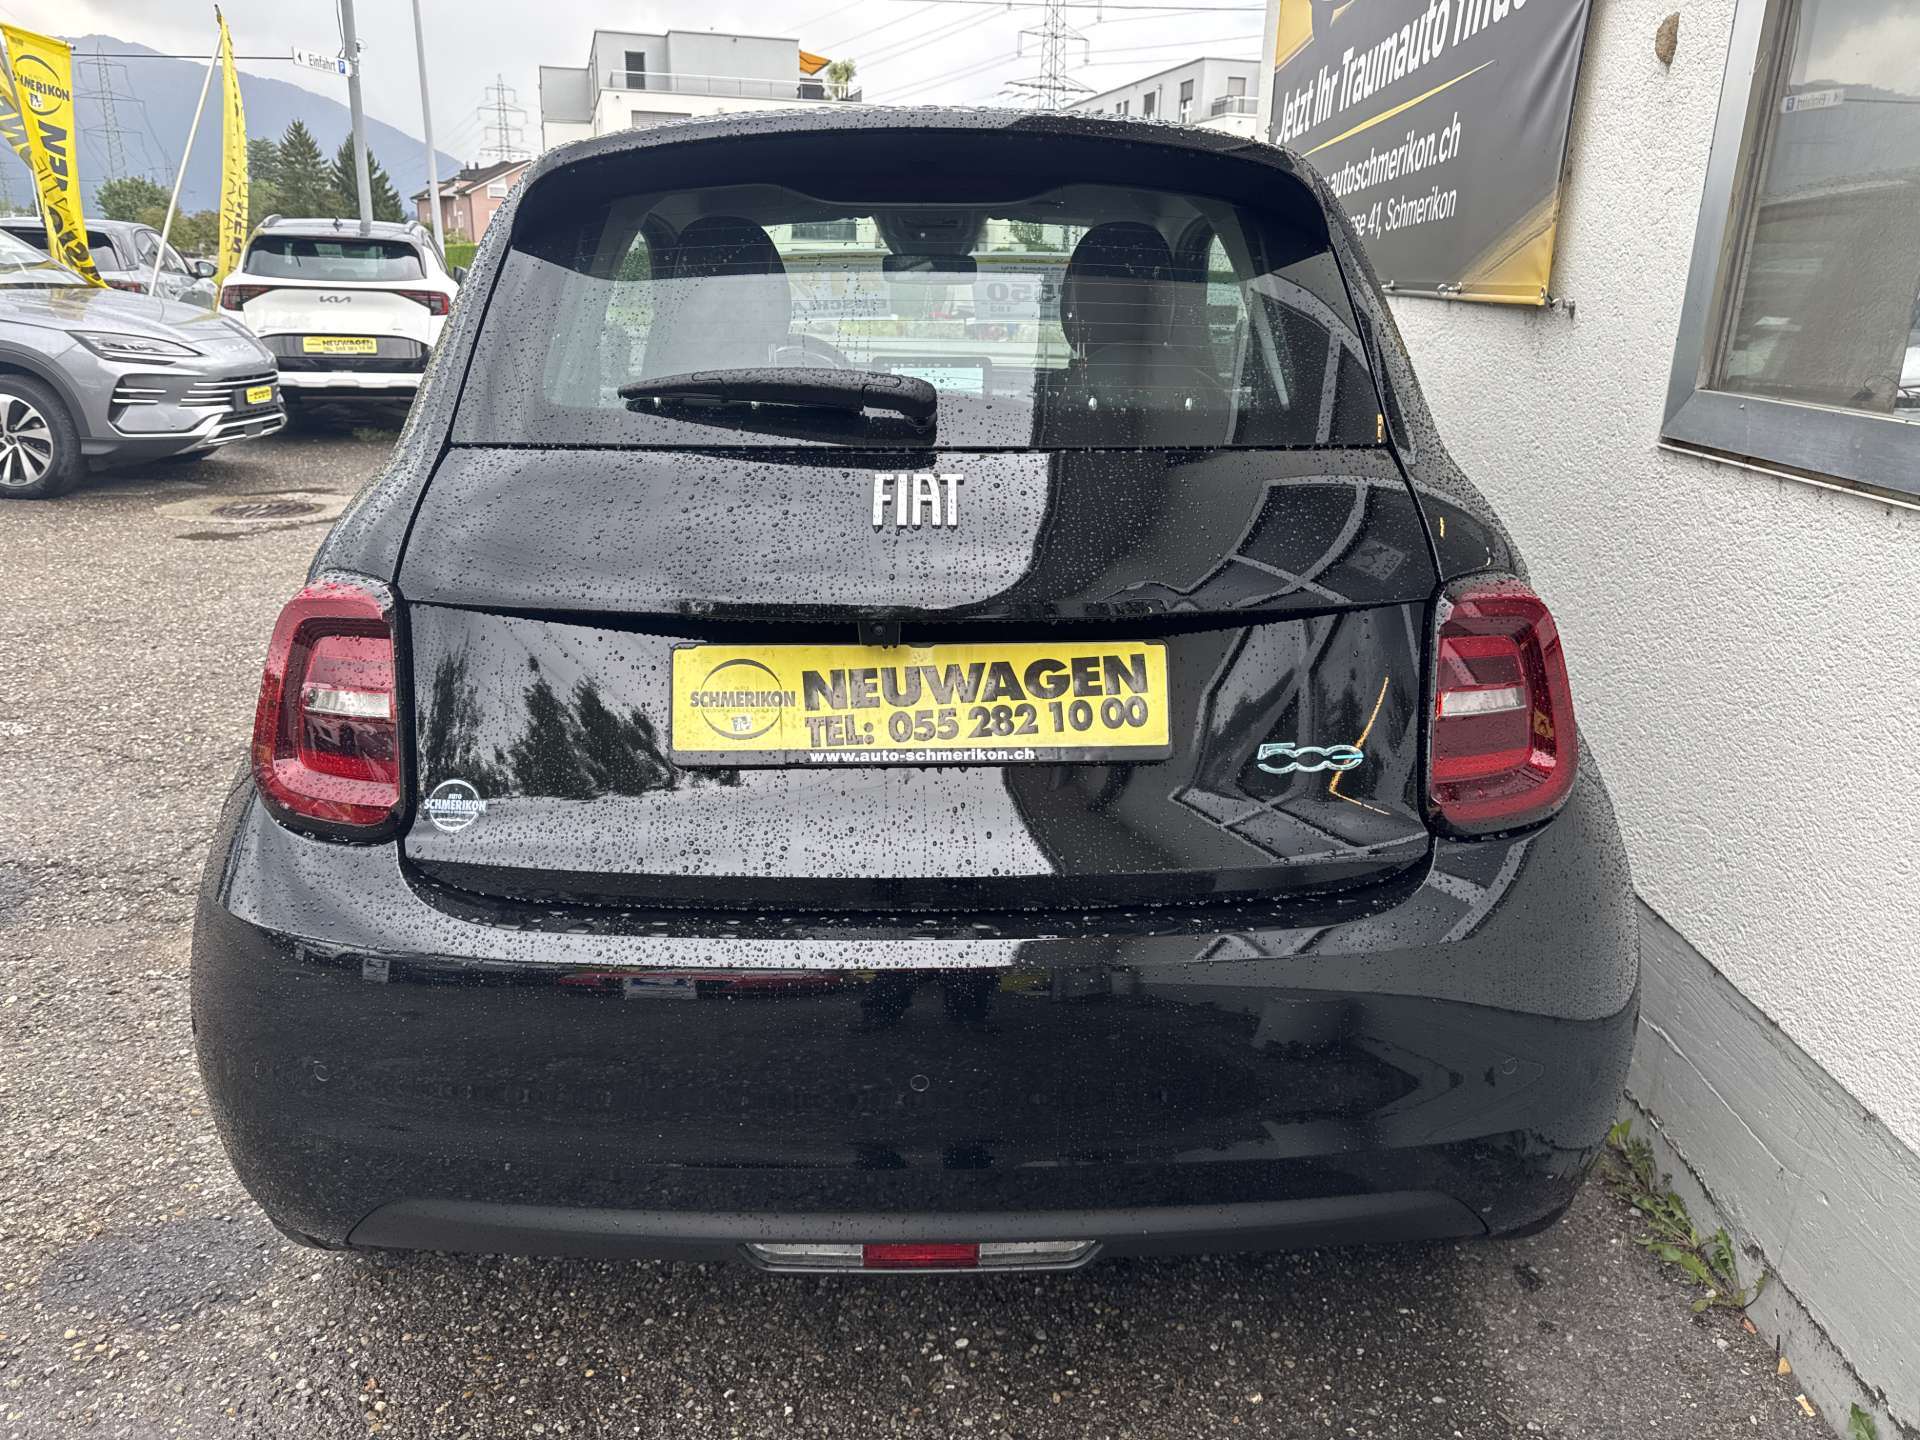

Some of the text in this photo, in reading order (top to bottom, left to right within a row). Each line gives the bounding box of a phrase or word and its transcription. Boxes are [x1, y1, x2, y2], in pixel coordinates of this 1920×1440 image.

[1276, 80, 1314, 145] Jetzt
[1312, 65, 1340, 127] Ihr
[1339, 0, 1451, 112] Traumauto
[1384, 185, 1457, 231] Schmerikon
[873, 474, 963, 526] FIAT
[690, 691, 796, 708] SCHMERIKON
[802, 653, 1149, 711] NEUWAGEN
[804, 697, 1149, 748] TEL: 055 282 10 00
[809, 748, 1036, 763] www.auto-schmerikon.ch
[424, 798, 487, 812] SCHMERIKON
